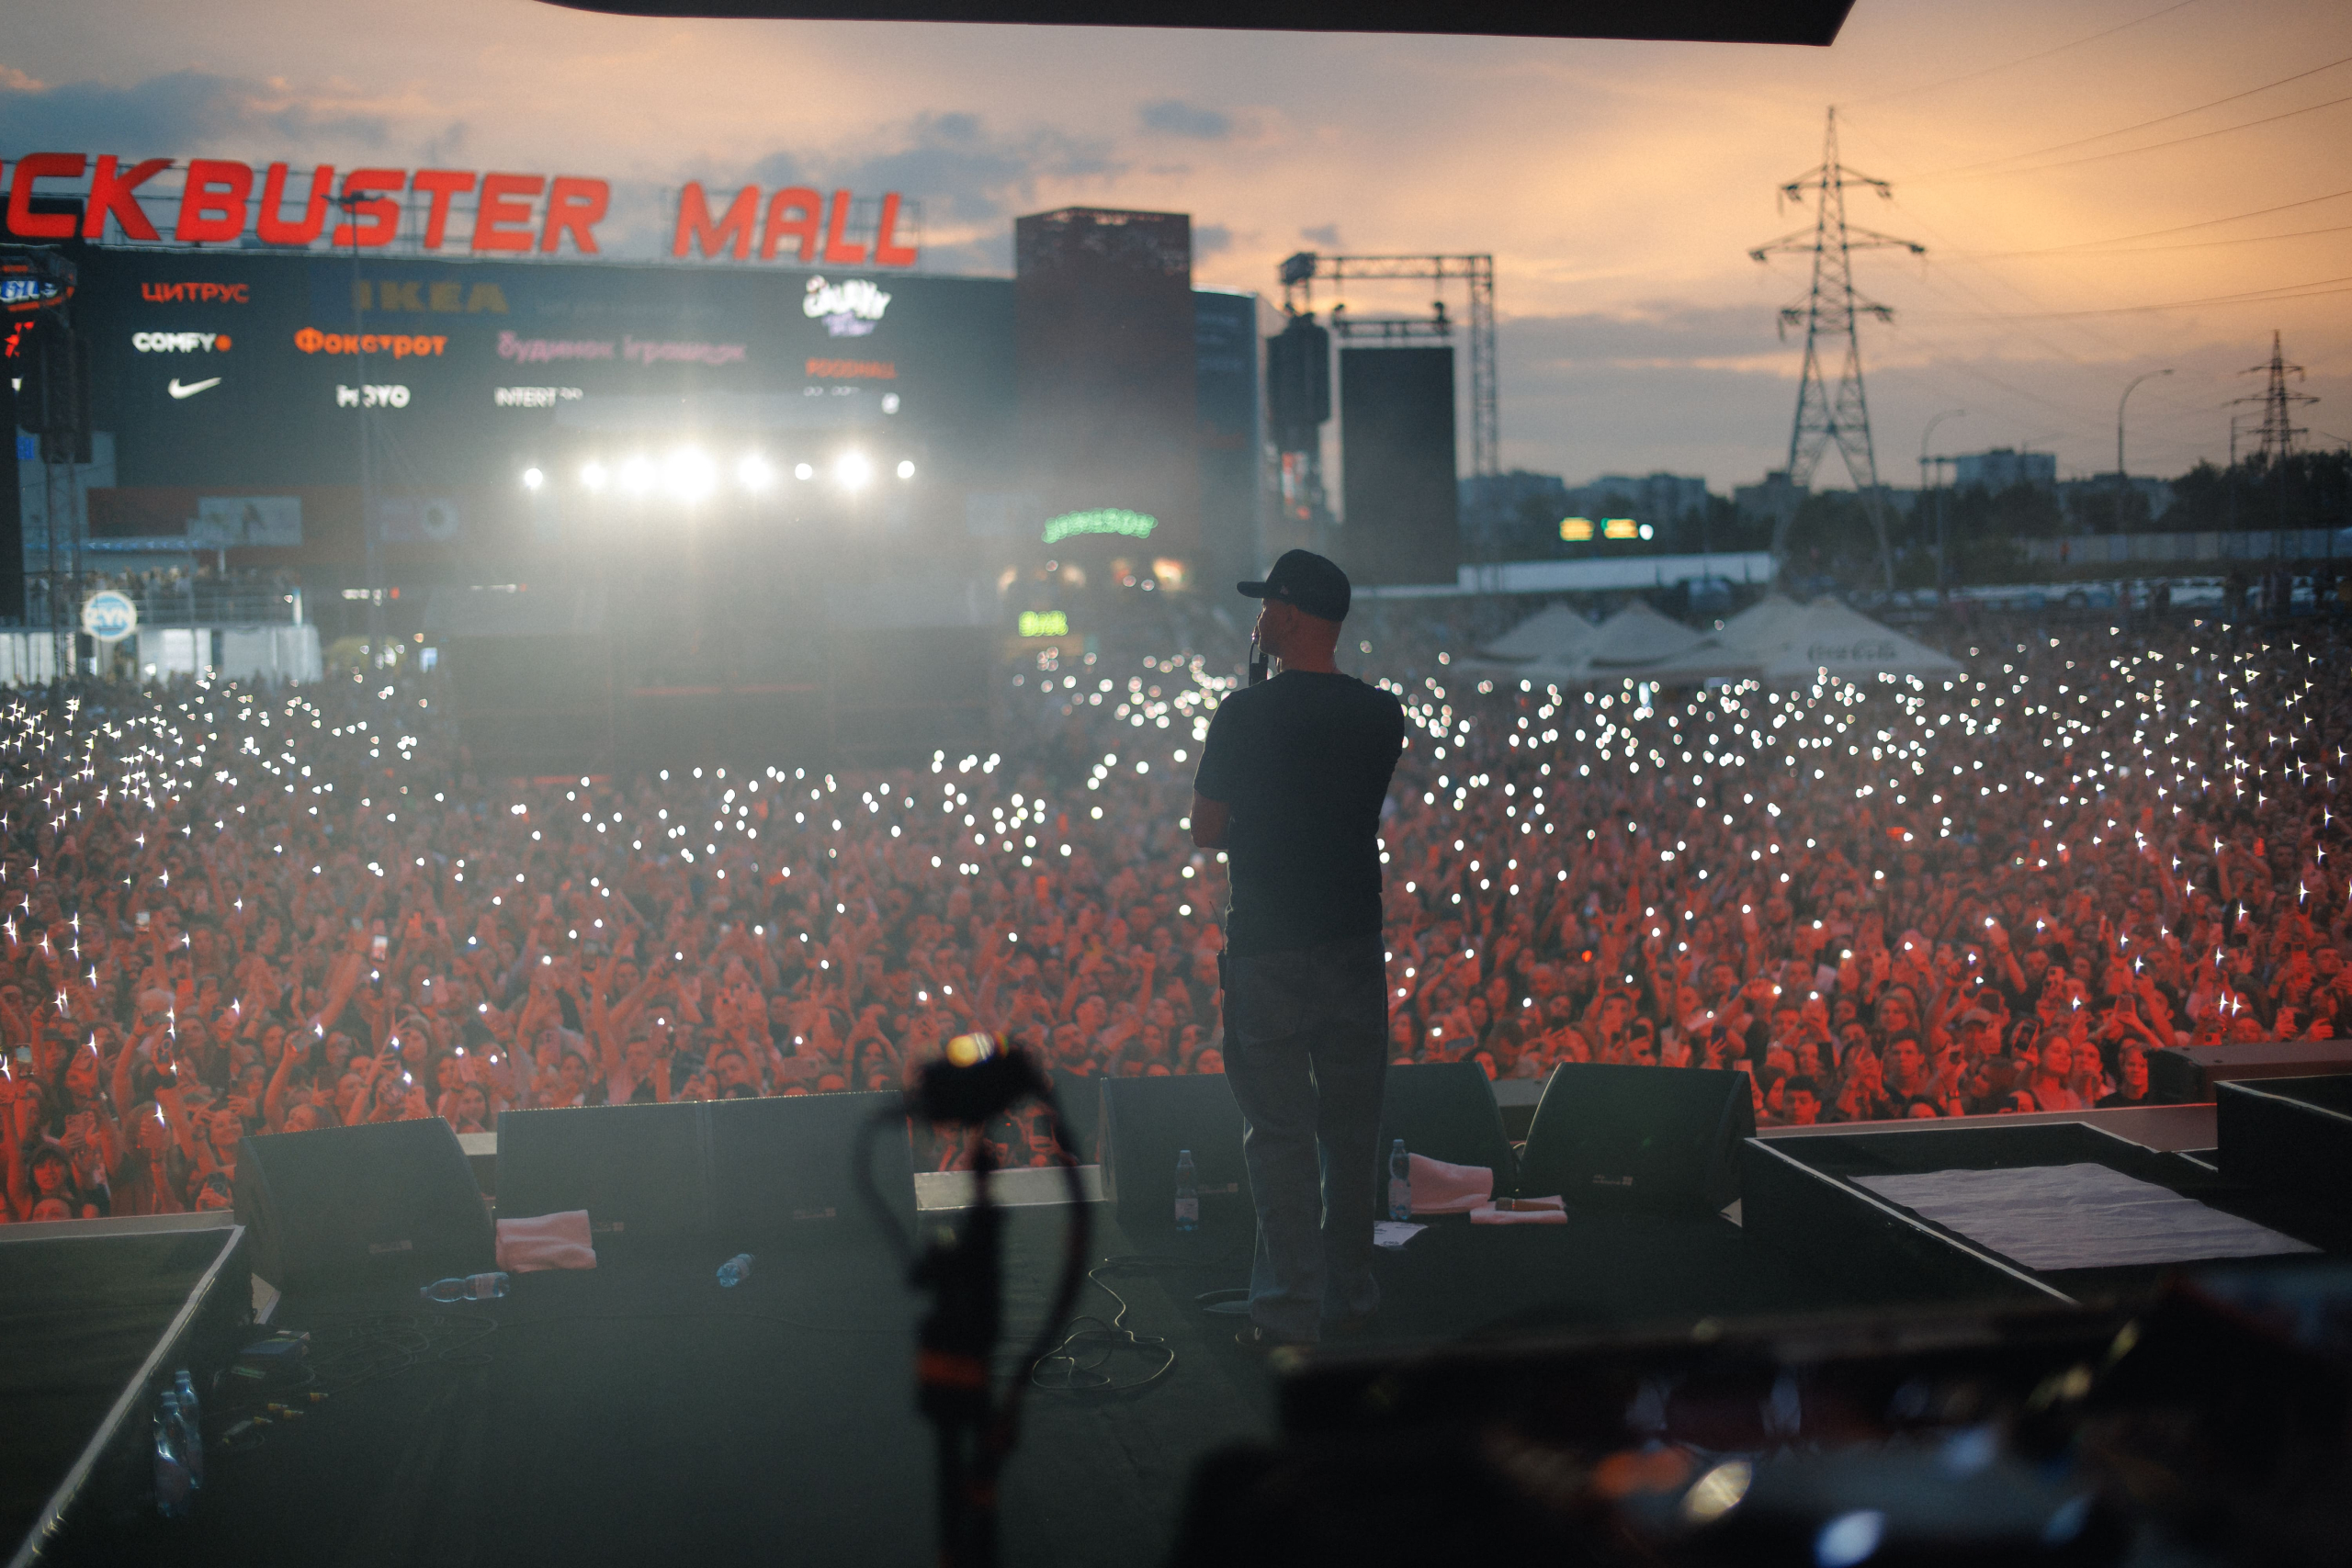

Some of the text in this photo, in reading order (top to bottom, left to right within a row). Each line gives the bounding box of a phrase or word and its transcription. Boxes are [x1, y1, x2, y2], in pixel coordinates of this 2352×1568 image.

[0, 152, 918, 267] CKBUSTER MALL
[141, 281, 250, 304] ЦИТРУС
[354, 279, 511, 314] IKEA
[131, 331, 217, 354] COMFY
[293, 326, 449, 360] Фокстрот
